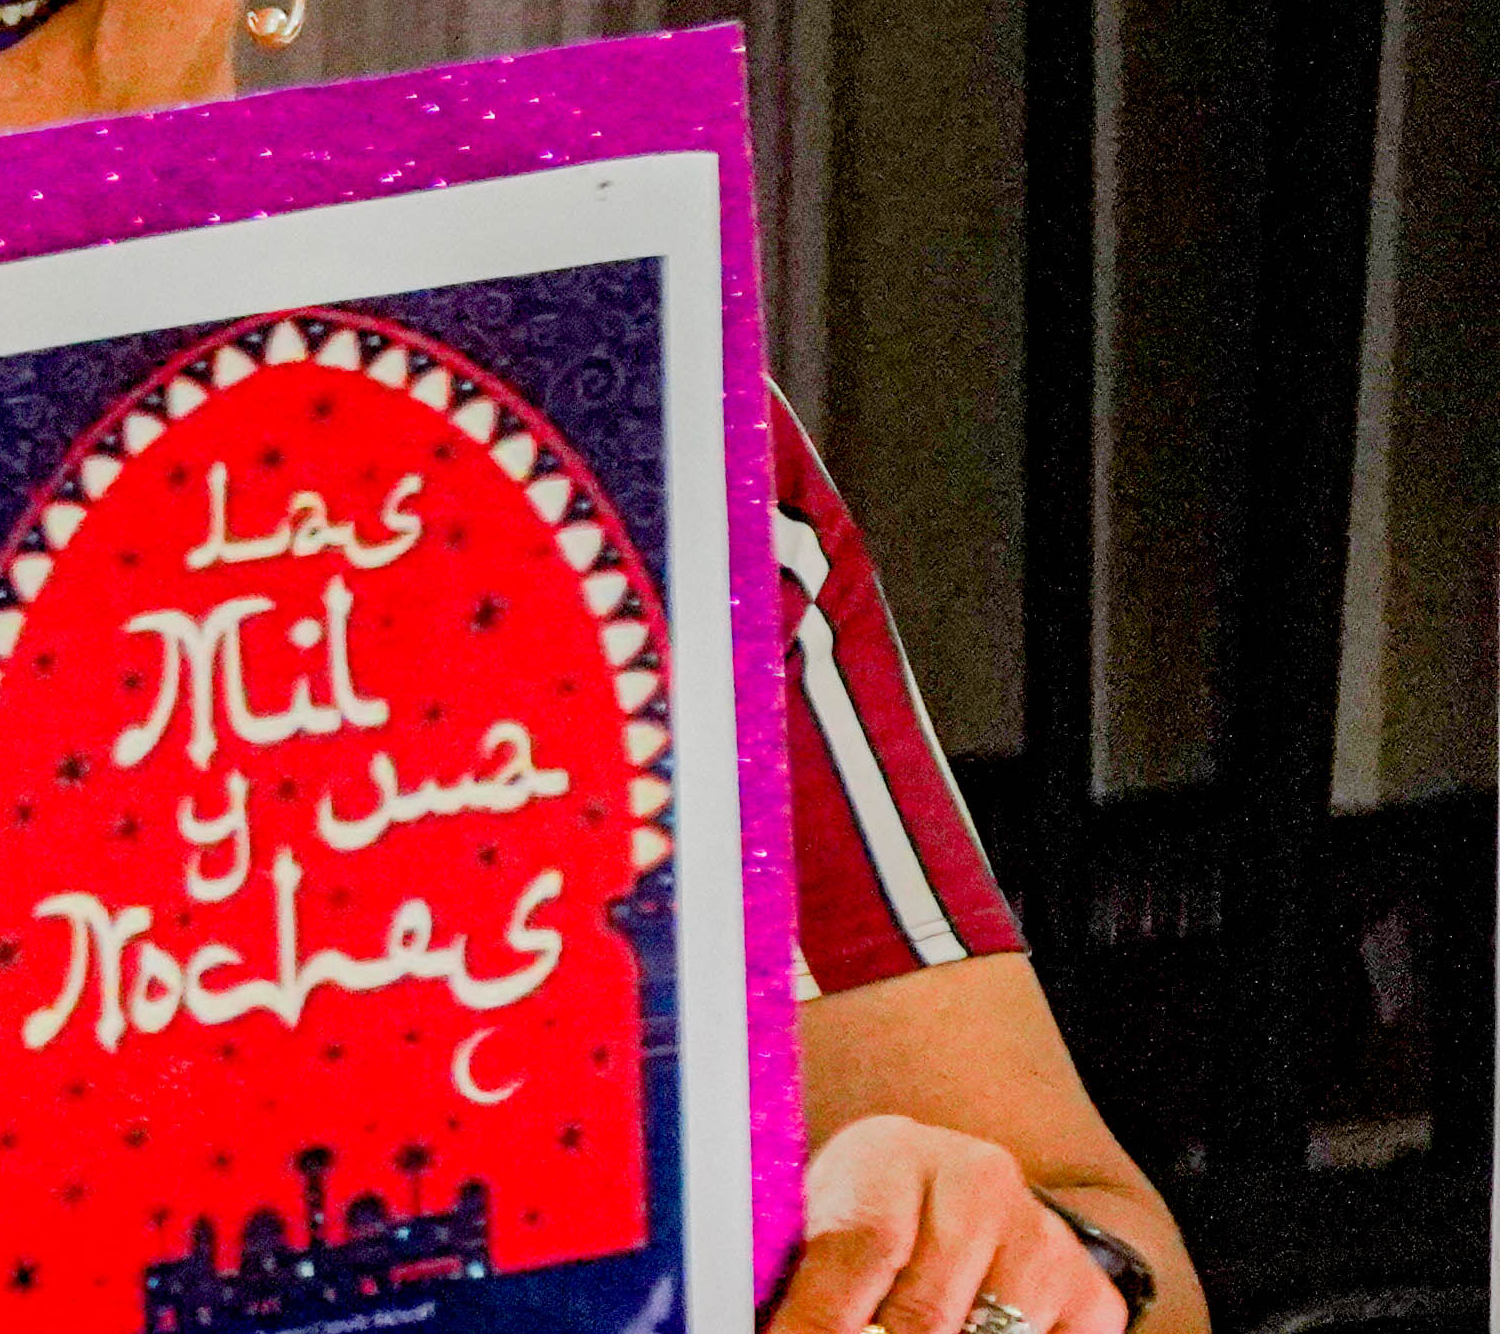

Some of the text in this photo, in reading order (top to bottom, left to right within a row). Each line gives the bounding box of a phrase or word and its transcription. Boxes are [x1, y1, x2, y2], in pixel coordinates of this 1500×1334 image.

[186, 462, 424, 570] Las
[112, 574, 389, 771] Mil
[177, 720, 569, 902] y una
[21, 849, 564, 1053] Noches
